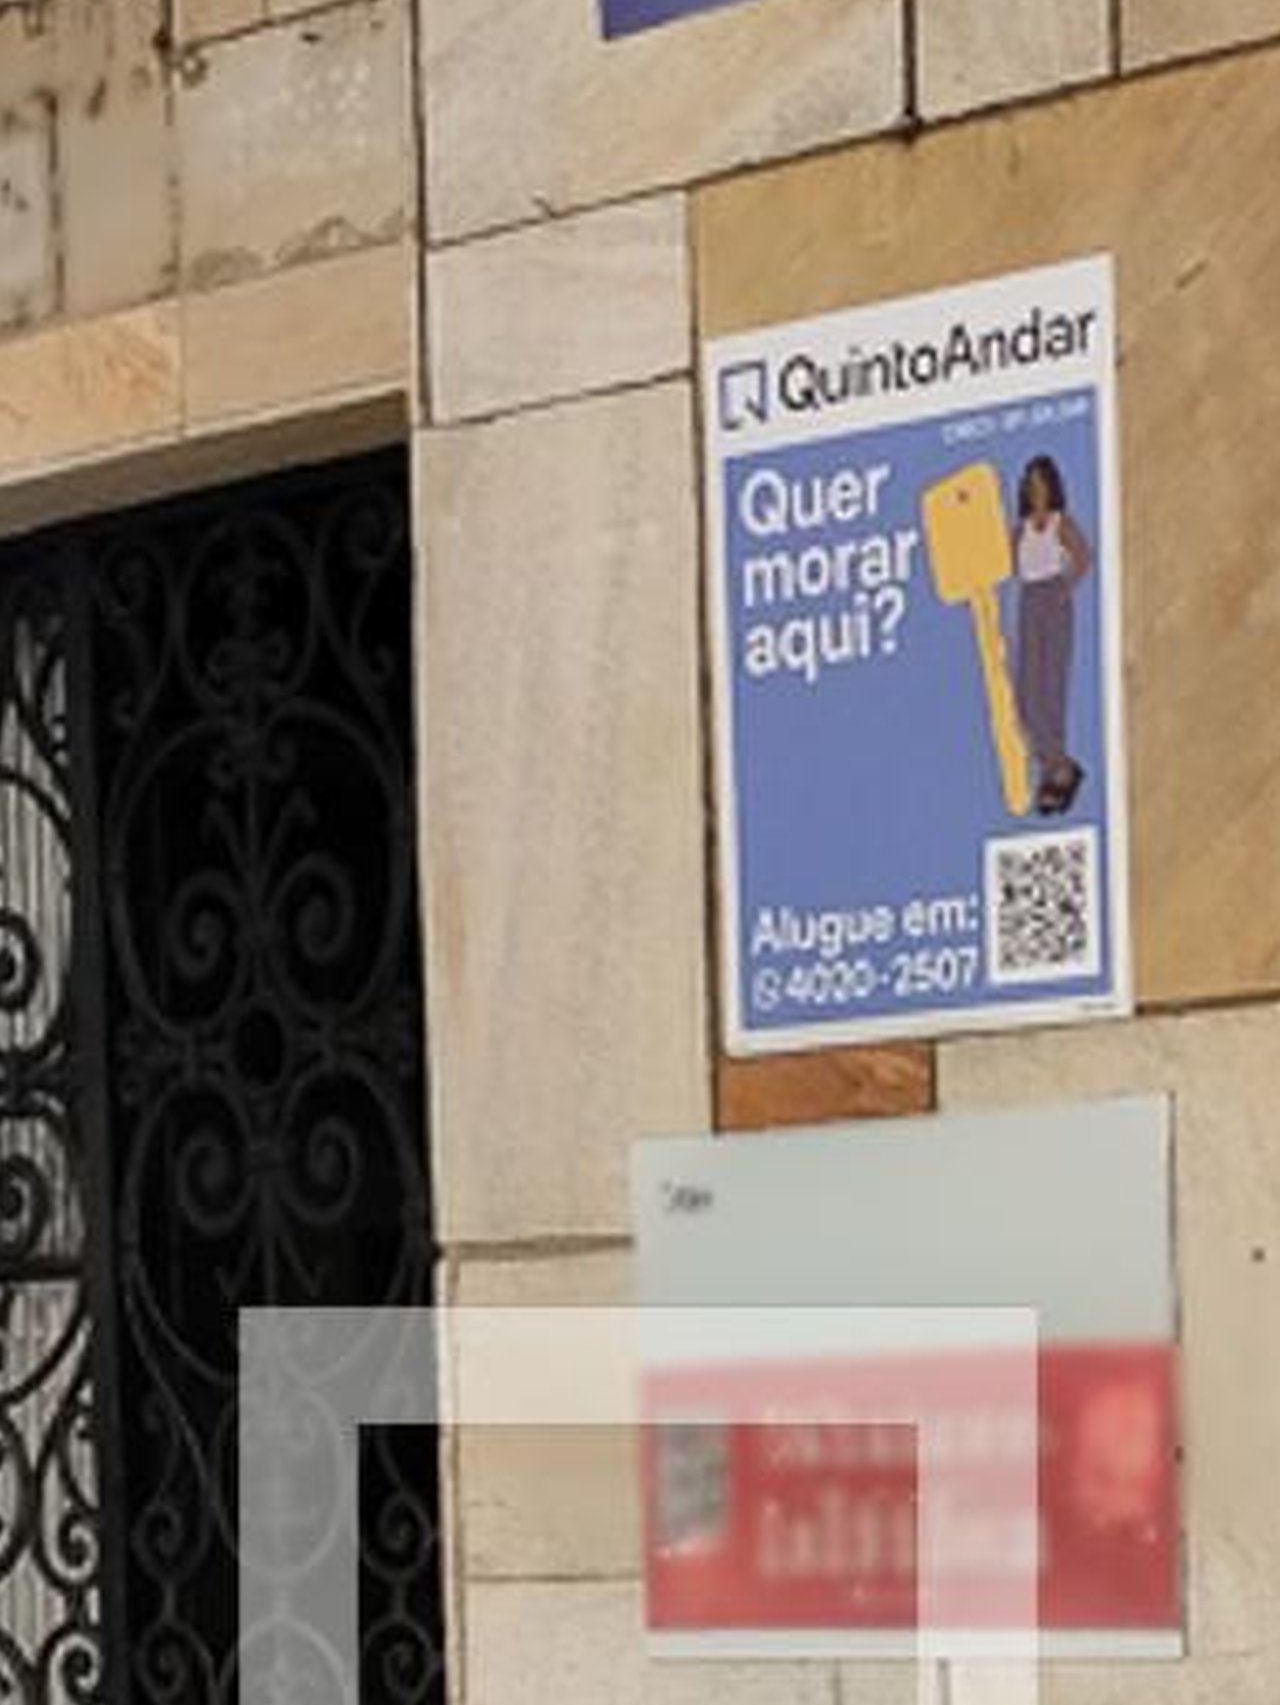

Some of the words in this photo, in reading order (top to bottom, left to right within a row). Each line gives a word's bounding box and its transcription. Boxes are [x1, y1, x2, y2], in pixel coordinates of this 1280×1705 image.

[778, 306, 1096, 413] QuintoAndar
[741, 463, 890, 536] Quer
[743, 529, 919, 607] morar
[745, 586, 906, 683] aqui?
[751, 905, 896, 958] Alugue
[902, 893, 980, 937] em:
